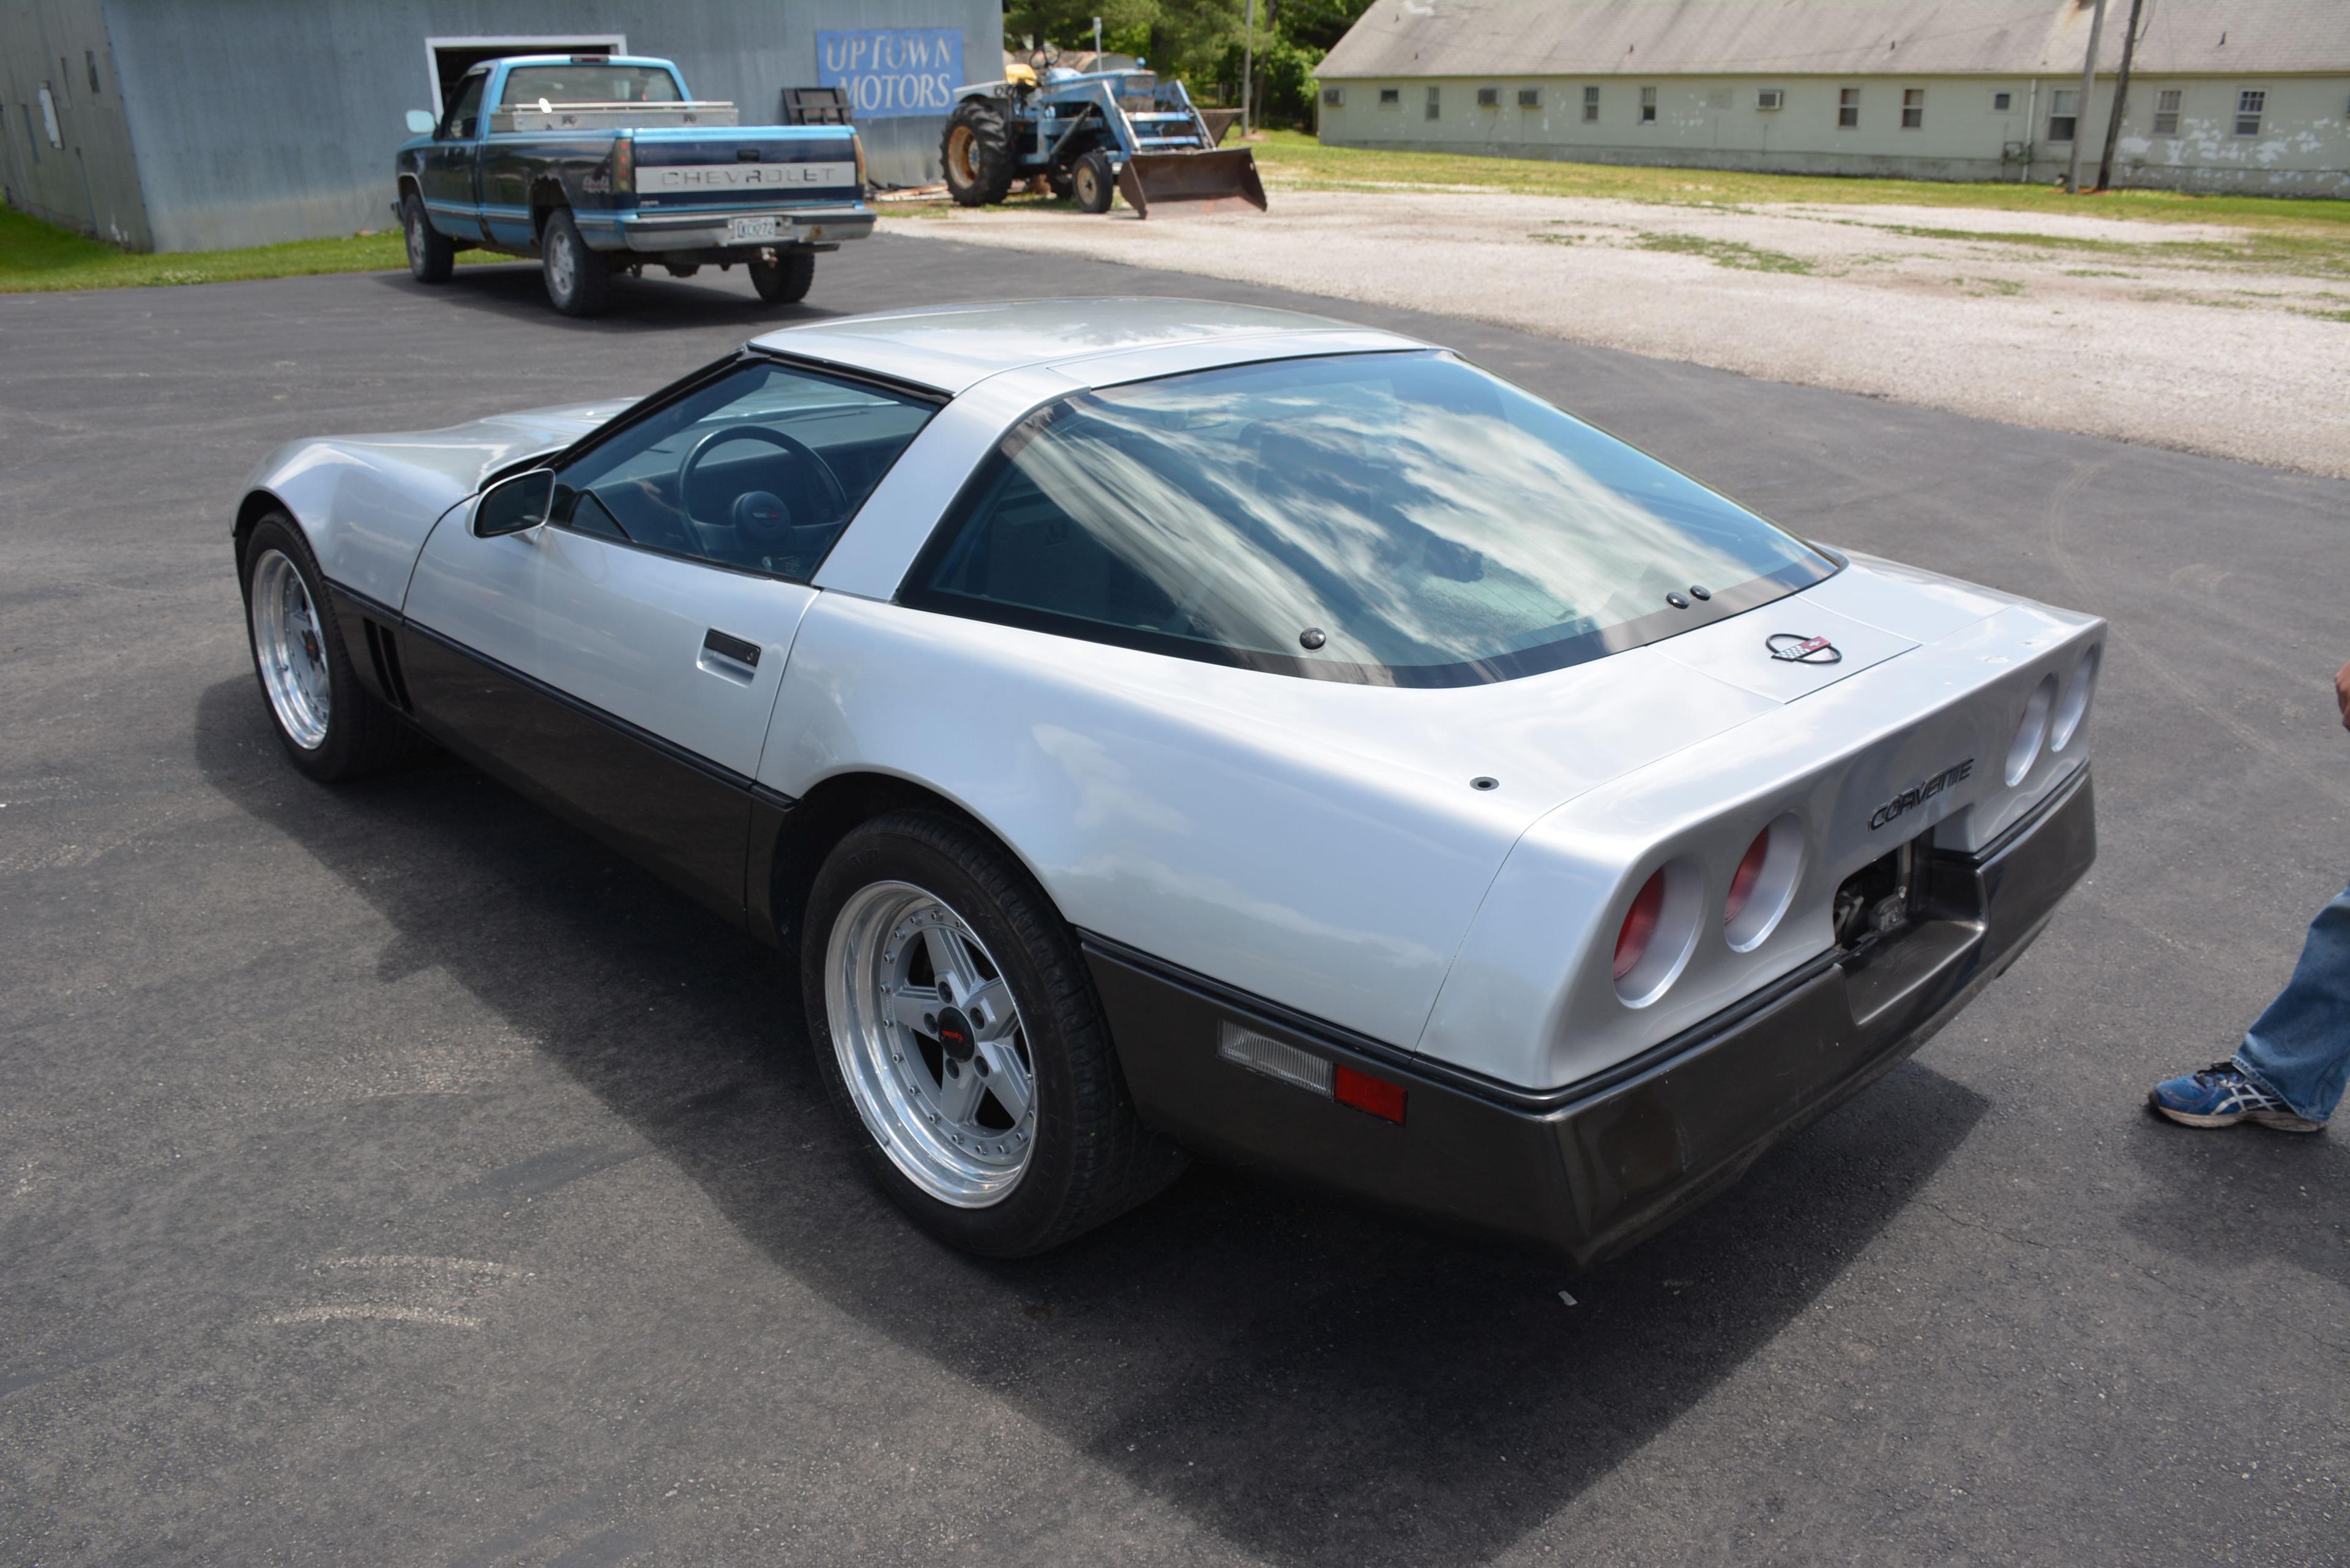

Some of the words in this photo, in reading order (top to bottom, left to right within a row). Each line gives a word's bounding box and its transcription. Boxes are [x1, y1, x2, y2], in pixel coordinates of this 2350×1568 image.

[827, 35, 952, 72] UPTOWN
[839, 72, 950, 111] MOTORS
[662, 168, 836, 185] CHEVROLET
[1868, 756, 1975, 832] CORVETTE
